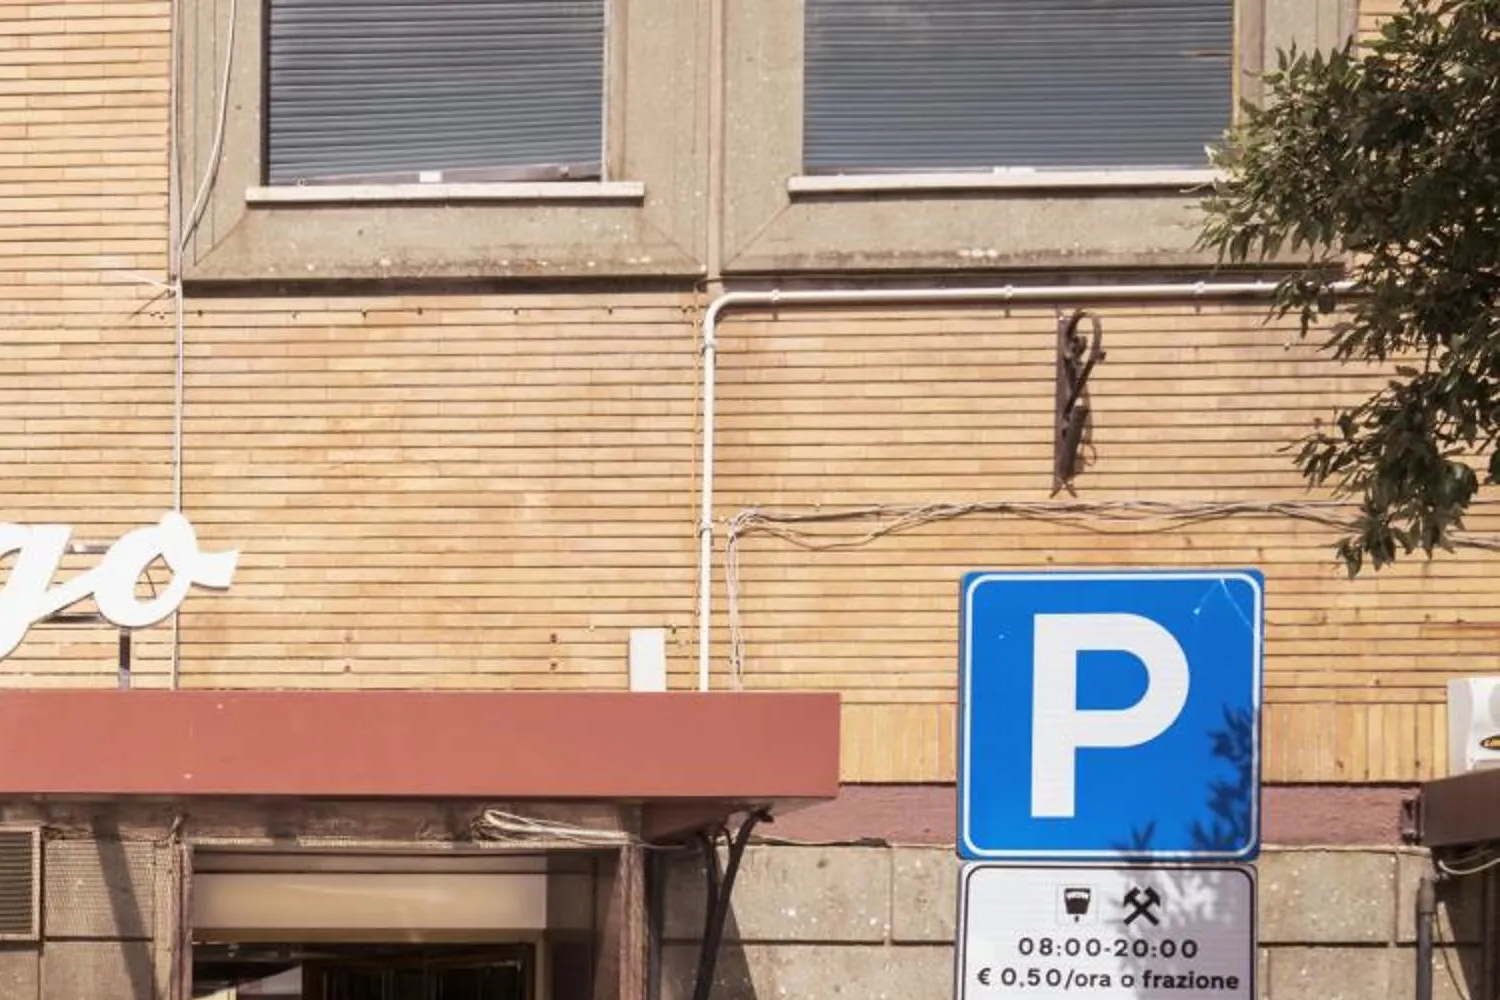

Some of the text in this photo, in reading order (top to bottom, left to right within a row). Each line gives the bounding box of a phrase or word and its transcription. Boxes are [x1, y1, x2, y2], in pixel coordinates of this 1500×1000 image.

[1031, 612, 1190, 818] P
[1018, 937, 1199, 959] 08:00-20:00
[977, 967, 991, 986] €
[1120, 973, 1135, 988] o
[1142, 970, 1239, 990] frazione
